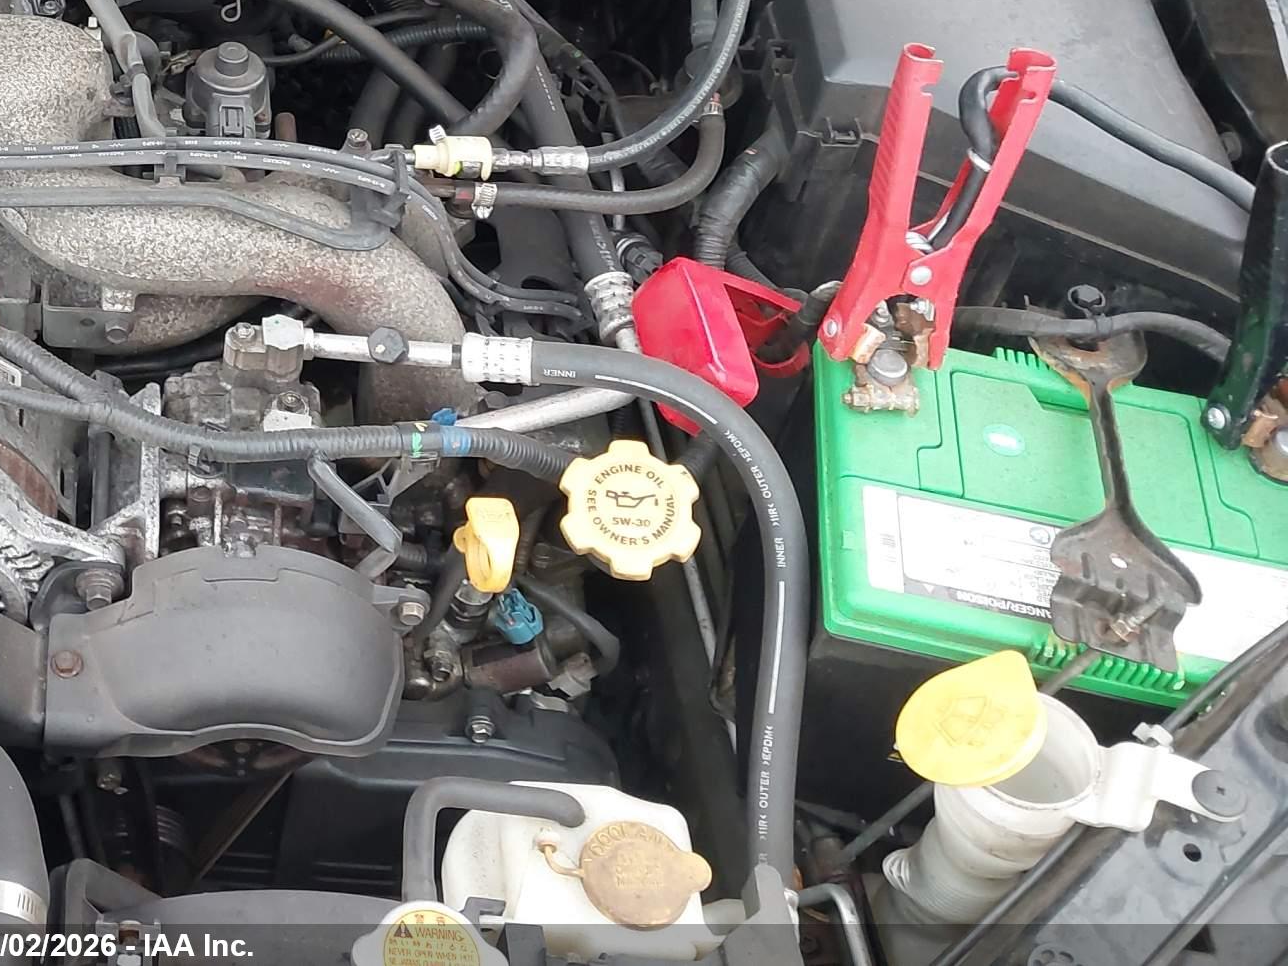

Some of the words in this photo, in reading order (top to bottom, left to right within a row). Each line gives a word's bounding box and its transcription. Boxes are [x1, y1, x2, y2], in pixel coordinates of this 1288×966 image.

[543, 368, 576, 379] INNER
[594, 464, 642, 485] ENGINE
[646, 470, 665, 489] OIL
[749, 465, 772, 499] OUTER
[587, 489, 597, 512] SEE
[592, 516, 650, 546] OWNER'S
[652, 494, 676, 540] MANUAL
[612, 517, 651, 527] 5W-30
[774, 537, 787, 568] INNER
[758, 770, 771, 809] OUTER
[415, 926, 464, 942] WARNING
